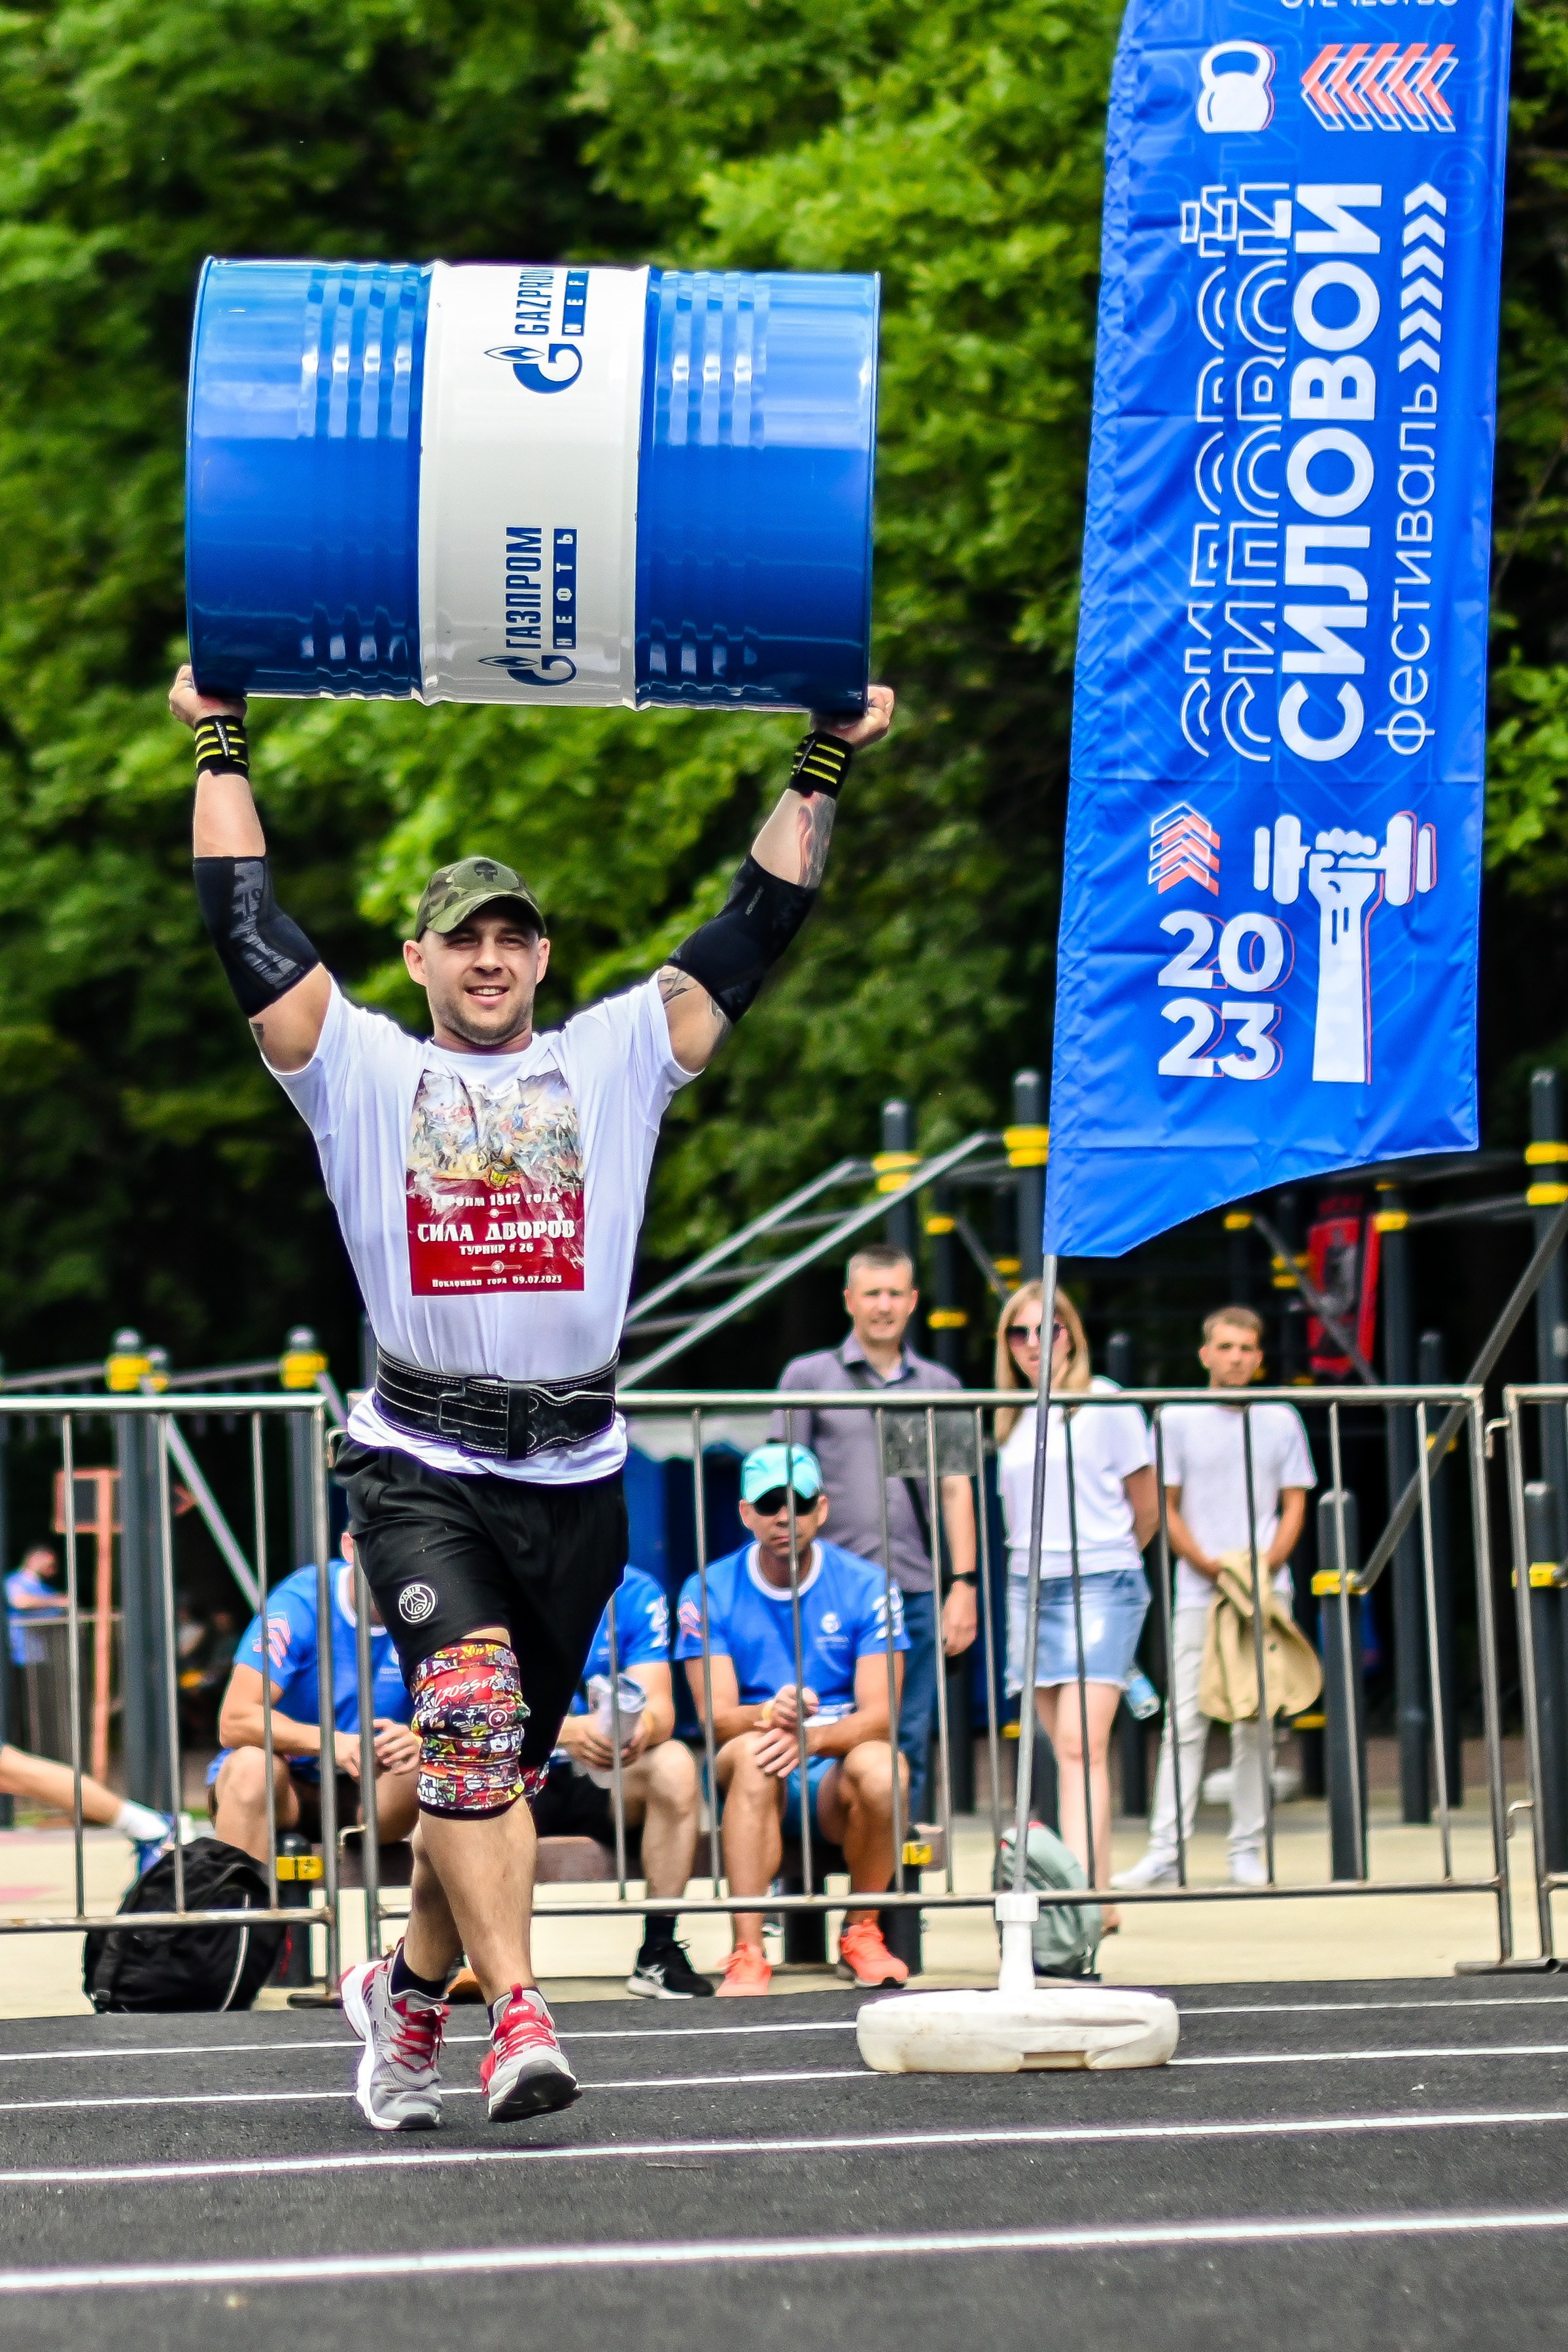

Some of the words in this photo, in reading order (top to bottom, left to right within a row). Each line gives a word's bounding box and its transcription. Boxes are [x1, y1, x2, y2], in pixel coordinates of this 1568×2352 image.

[505, 526, 542, 650] ГАЗПРОМ
[555, 534, 574, 647] НЕФТЬ
[1157, 910, 1284, 993] 20
[1157, 998, 1277, 1081] 23
[490, 1193, 521, 1206] 1812
[417, 1223, 474, 1242] СИЛА
[485, 1220, 576, 1241] ДВОРОВ
[459, 1244, 506, 1255] ТУРНИР
[519, 1243, 534, 1253] 26
[512, 1275, 562, 1284] 09.07.2023
